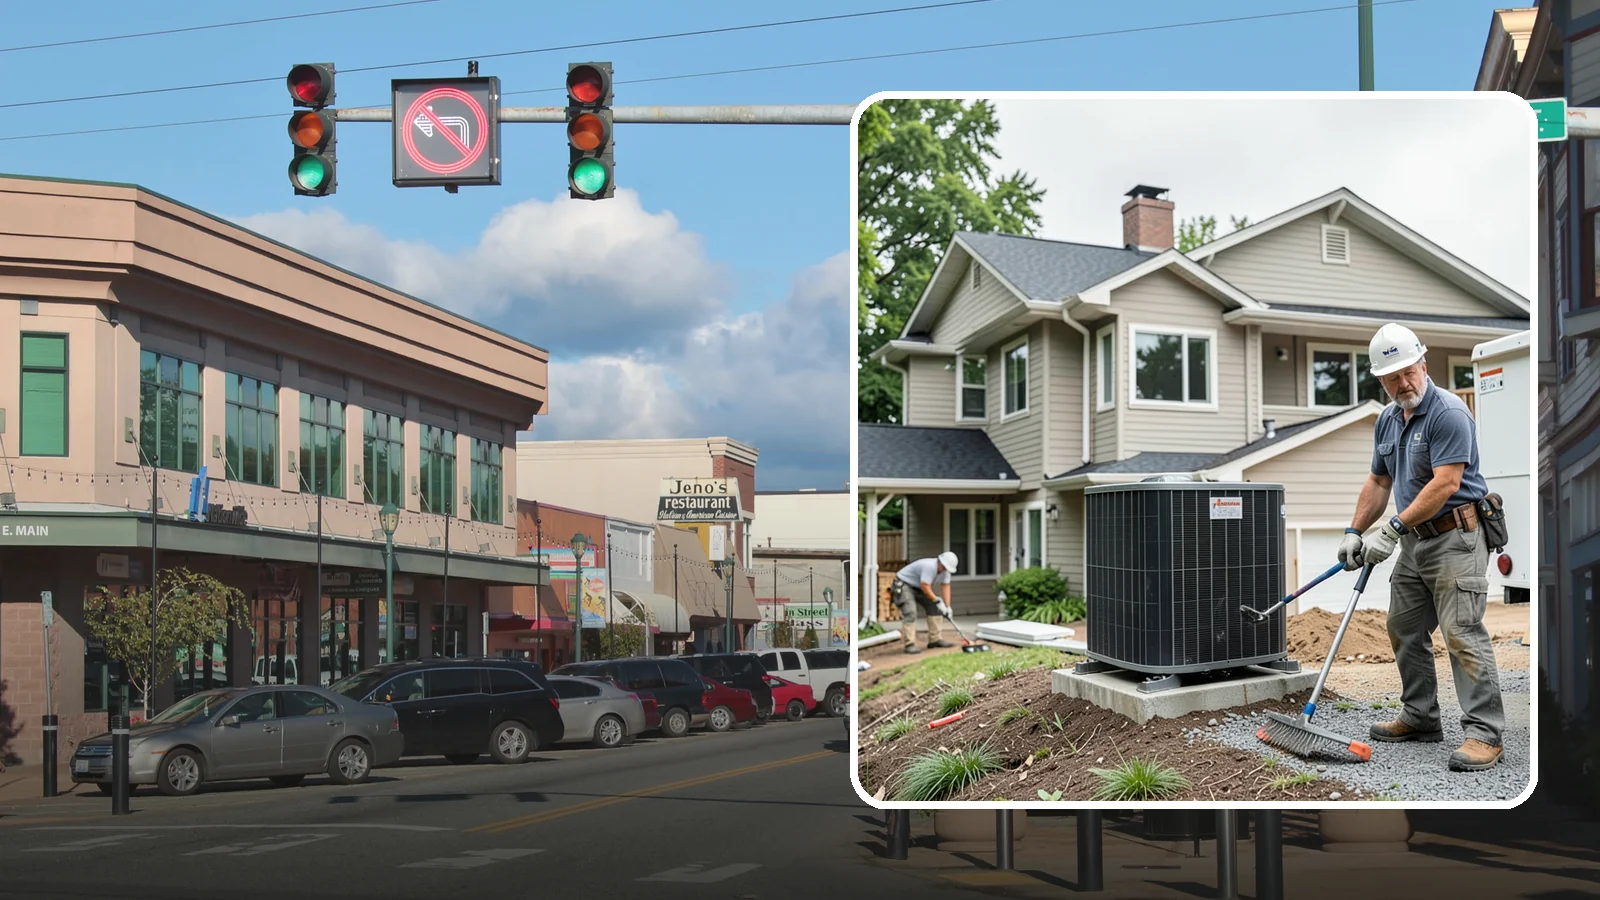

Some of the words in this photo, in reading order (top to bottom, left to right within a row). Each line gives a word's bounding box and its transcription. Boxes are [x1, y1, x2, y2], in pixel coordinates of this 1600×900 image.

[669, 480, 728, 495] Jeno's
[665, 496, 731, 509] restaurant
[686, 509, 714, 519] American
[714, 509, 738, 519] Cuisine
[2, 525, 13, 536] E.
[15, 525, 49, 536] MAIN
[797, 608, 828, 617] Street
[791, 619, 823, 627] lass
